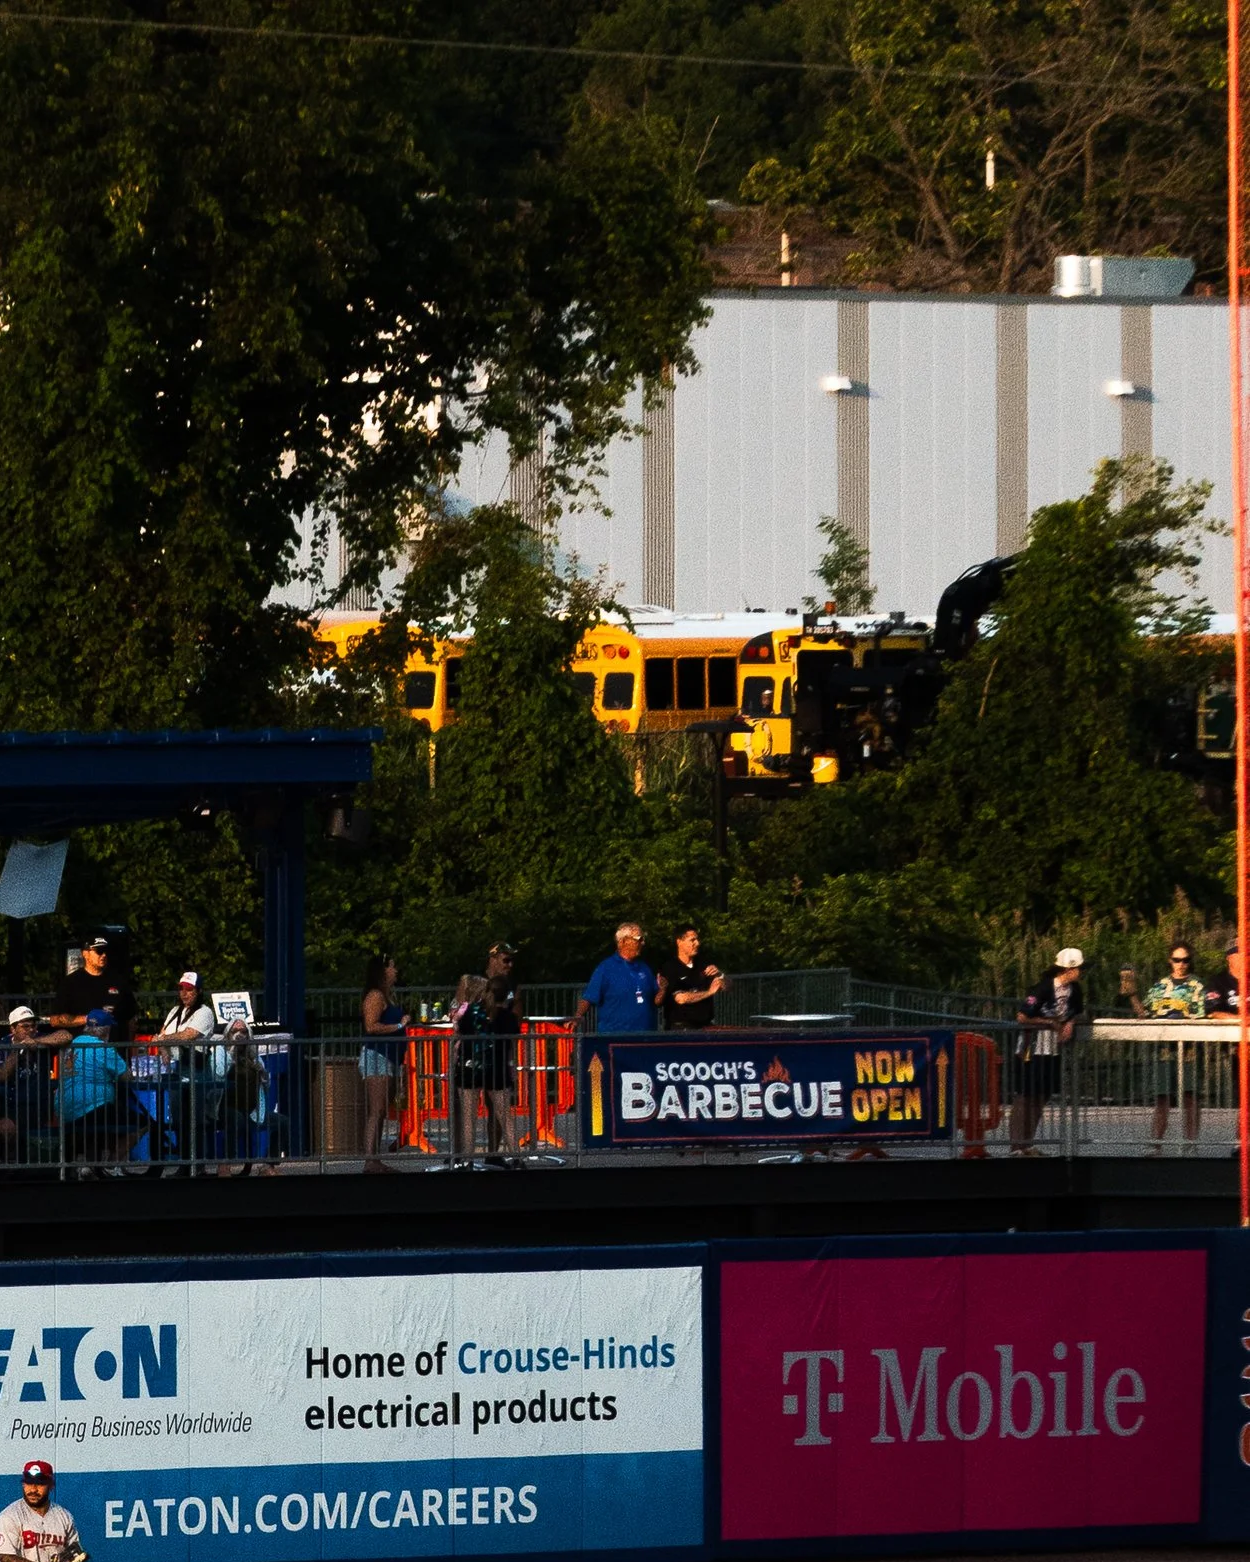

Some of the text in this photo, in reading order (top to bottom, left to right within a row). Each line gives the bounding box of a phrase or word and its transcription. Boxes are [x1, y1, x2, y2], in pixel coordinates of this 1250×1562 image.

[655, 1061, 756, 1081] SCOOCH'S
[854, 1050, 915, 1084] NOW
[621, 1071, 844, 1119] BARBECUE
[852, 1088, 922, 1121] OPEN
[305, 1335, 675, 1379] Home of Crouse-Hinds
[870, 1341, 1147, 1443] Mobile
[10, 1410, 252, 1443] Powering Business Worldwide
[304, 1389, 618, 1435] electrical products
[104, 1484, 538, 1539] EATON.COM/CAREERS
[22, 1530, 70, 1550] BUFFAL
